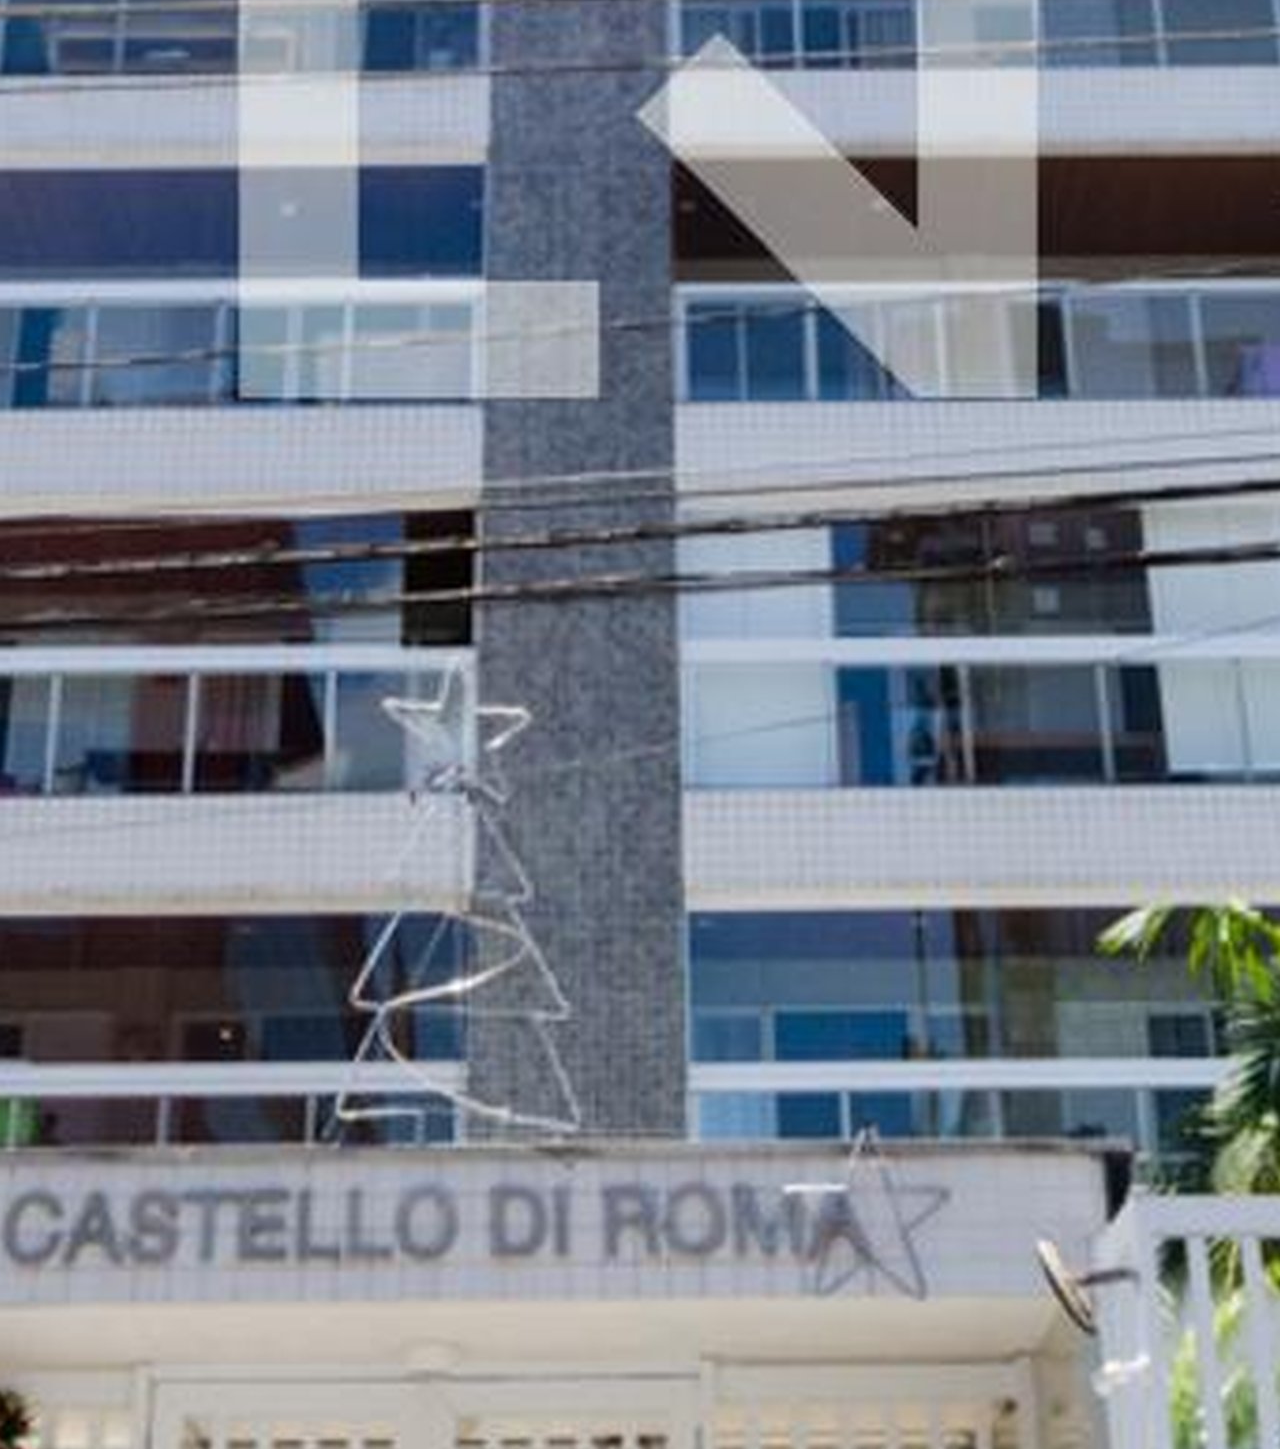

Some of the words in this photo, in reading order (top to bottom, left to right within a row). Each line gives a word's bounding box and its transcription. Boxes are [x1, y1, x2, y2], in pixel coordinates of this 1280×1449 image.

[1, 1184, 460, 1266] CASTELLO
[488, 1182, 570, 1259] DI
[600, 1182, 870, 1263] ROMA
